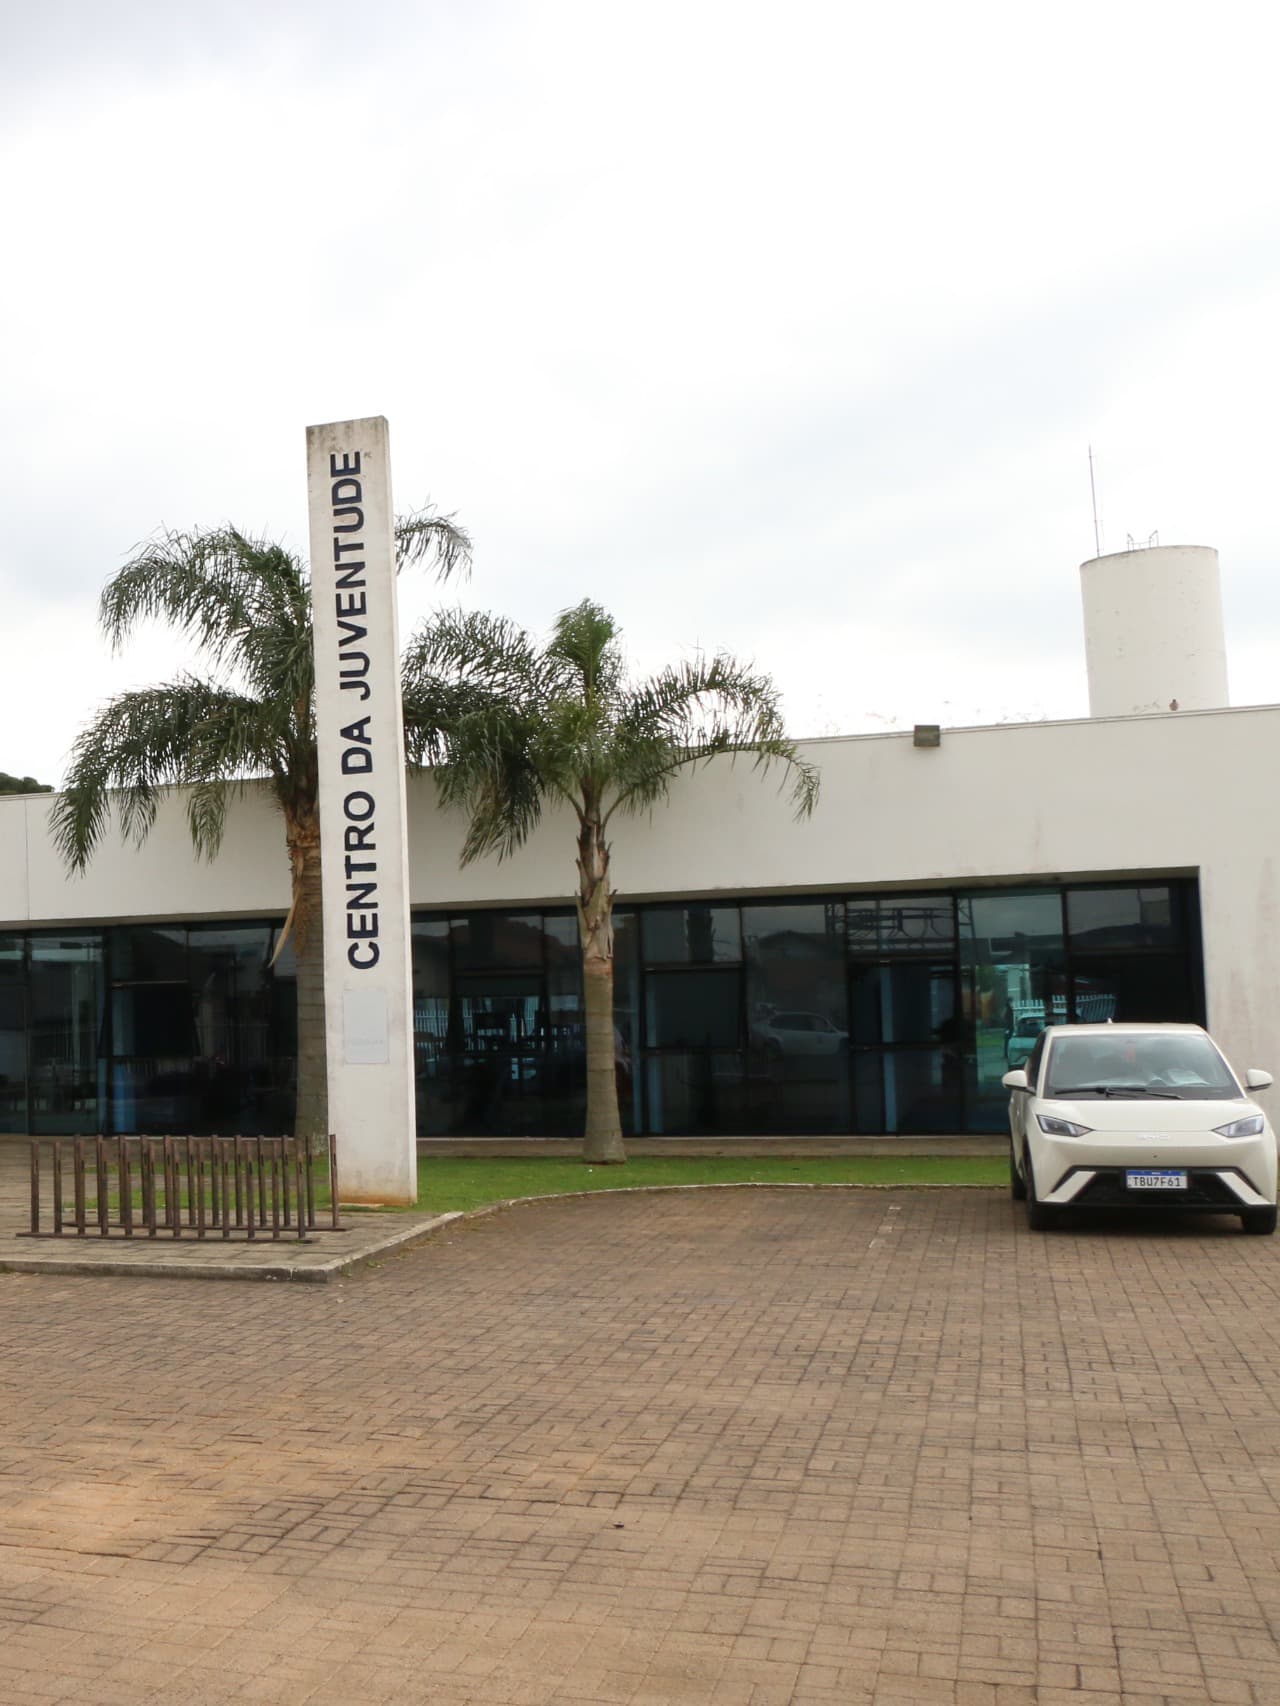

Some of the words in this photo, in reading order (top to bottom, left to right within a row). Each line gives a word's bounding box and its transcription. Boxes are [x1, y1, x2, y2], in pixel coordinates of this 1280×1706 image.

[330, 451, 371, 701] JUVENTUDE
[340, 715, 373, 775] DA
[343, 790, 380, 970] CENTRO
[1132, 1176, 1181, 1187] TBU7F61
